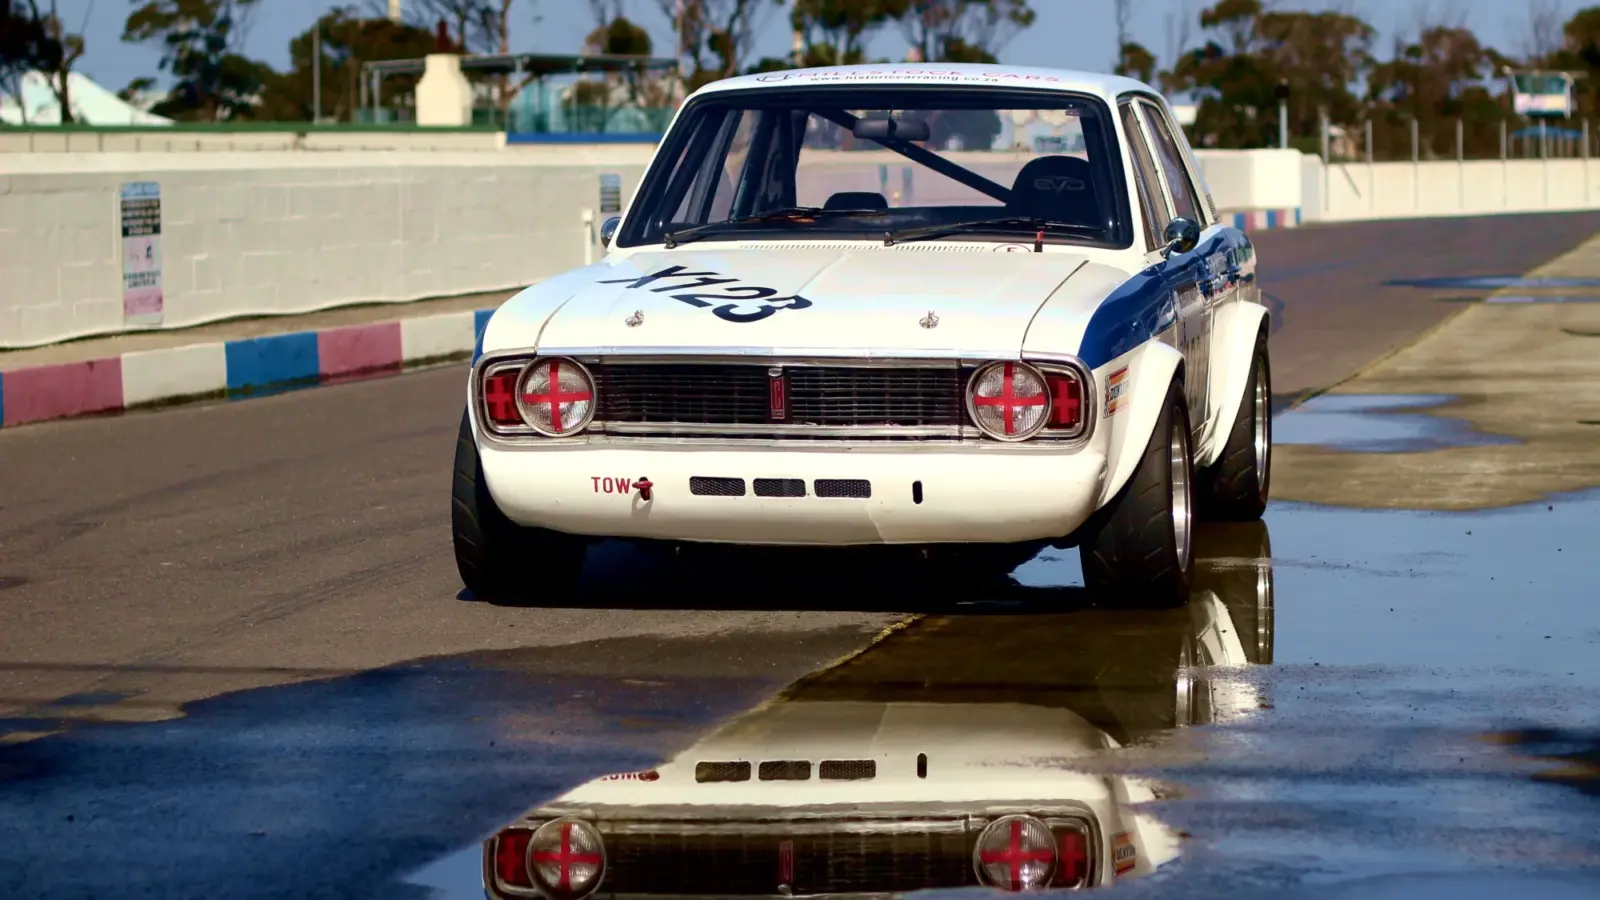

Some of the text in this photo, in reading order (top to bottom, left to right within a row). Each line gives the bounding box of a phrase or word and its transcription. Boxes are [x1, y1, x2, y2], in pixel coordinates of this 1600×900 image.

[981, 72, 1059, 82] CARS
[596, 265, 813, 323] X123
[590, 476, 631, 494] TOW
